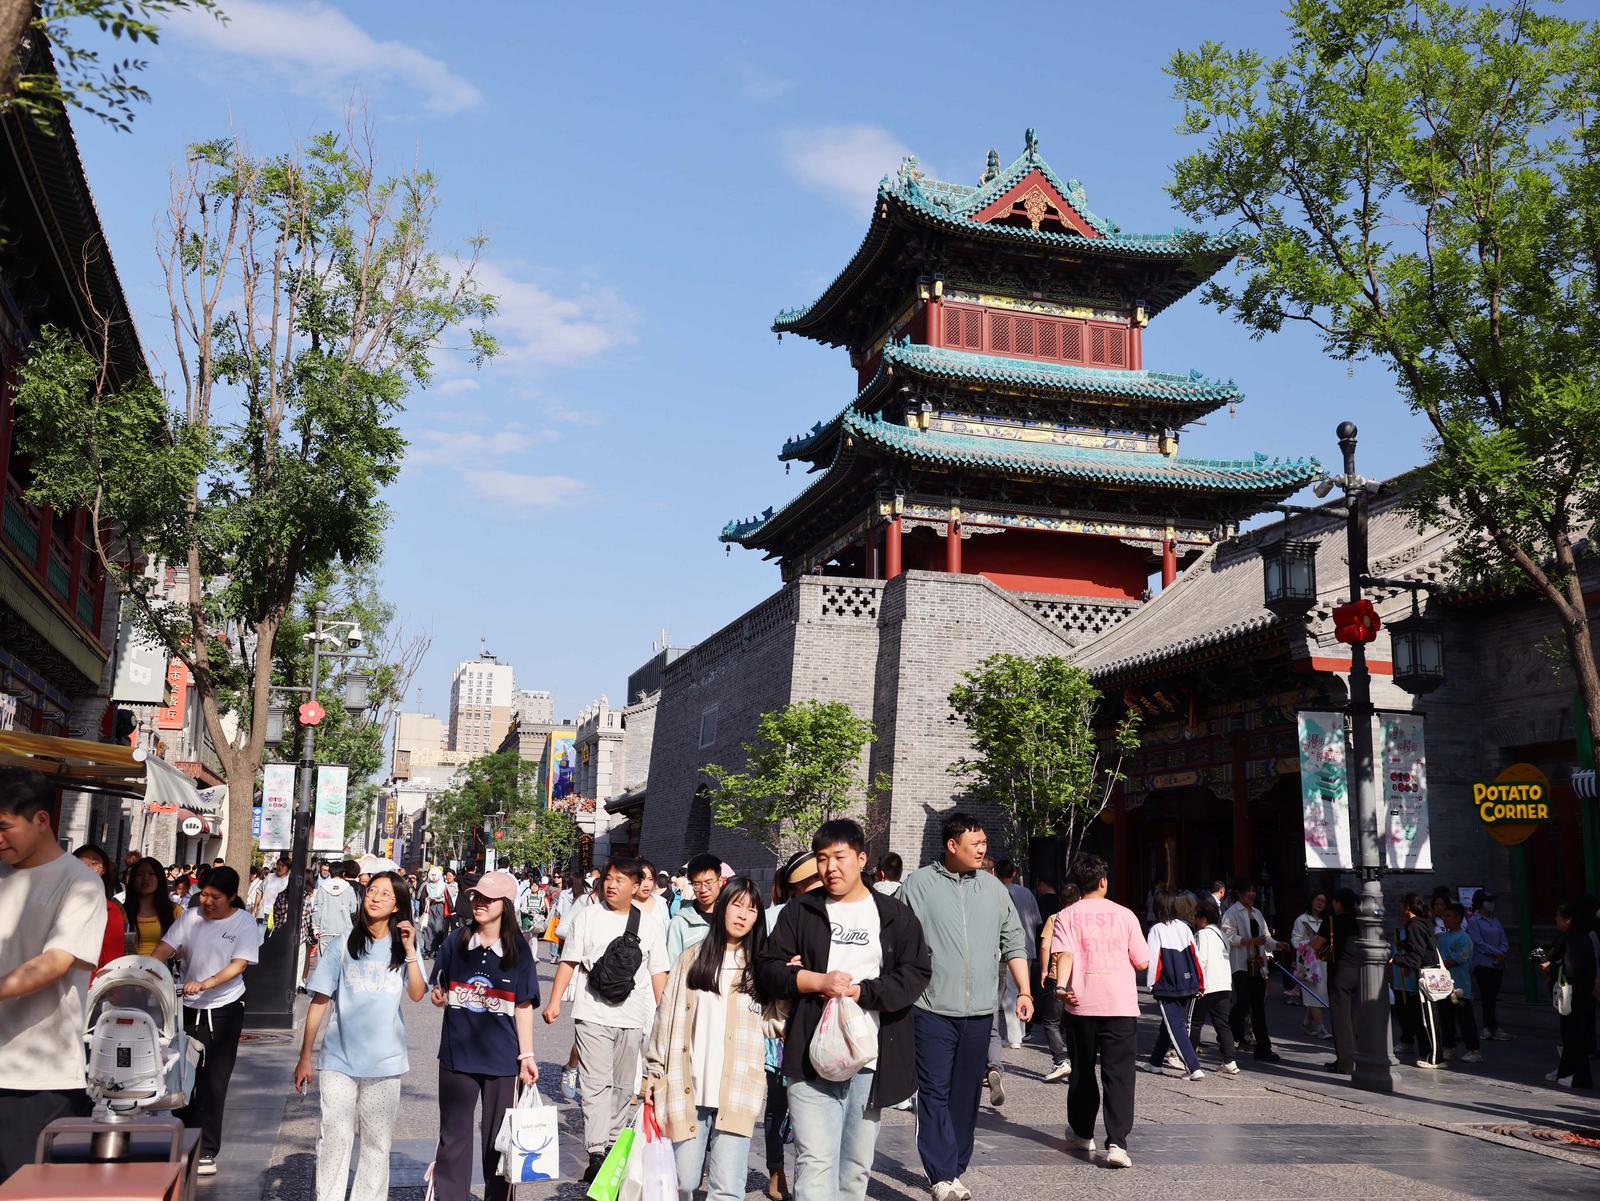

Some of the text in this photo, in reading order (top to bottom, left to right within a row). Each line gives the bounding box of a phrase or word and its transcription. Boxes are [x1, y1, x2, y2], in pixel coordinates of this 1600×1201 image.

[1473, 783, 1542, 804] POTATO
[1480, 801, 1548, 822] CORNER
[455, 986, 500, 1011] Change
[474, 981, 487, 995] To
